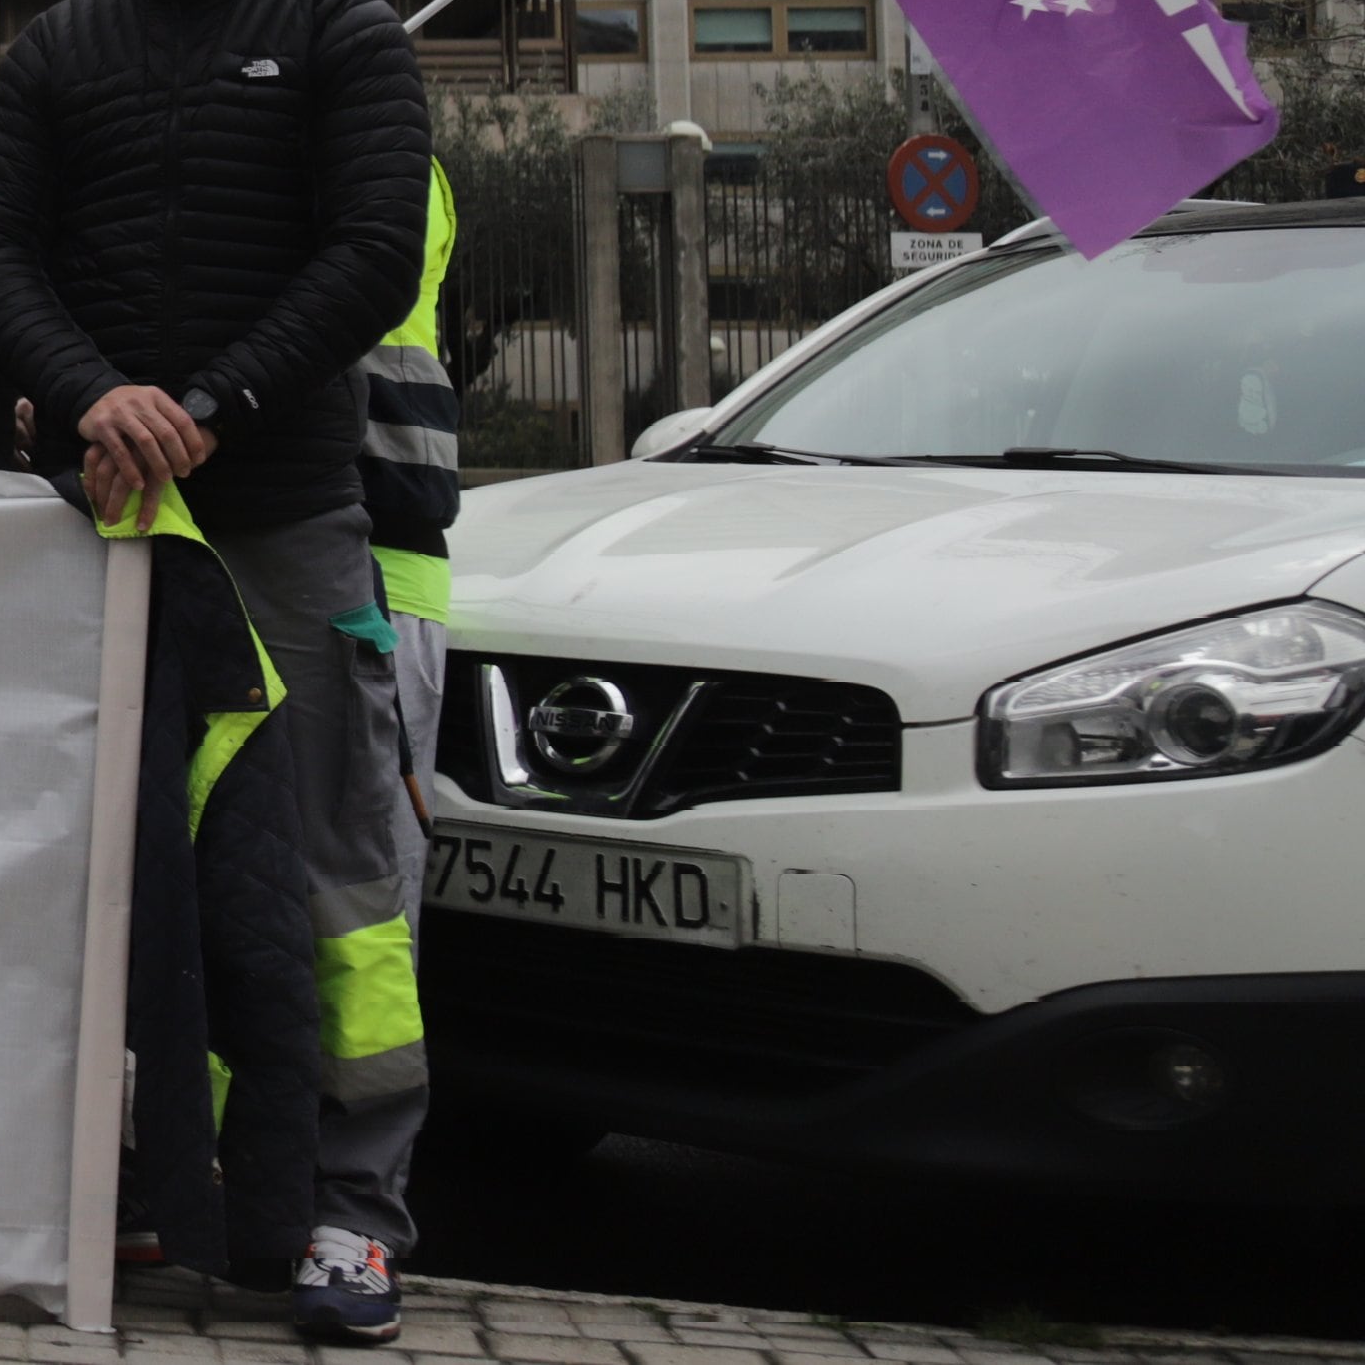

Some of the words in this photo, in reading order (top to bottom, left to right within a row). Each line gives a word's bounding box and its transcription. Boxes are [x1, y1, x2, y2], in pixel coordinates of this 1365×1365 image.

[909, 239, 943, 249] ZONA
[948, 239, 964, 250] DE
[432, 834, 565, 914] 7544
[595, 853, 710, 930] HKD
